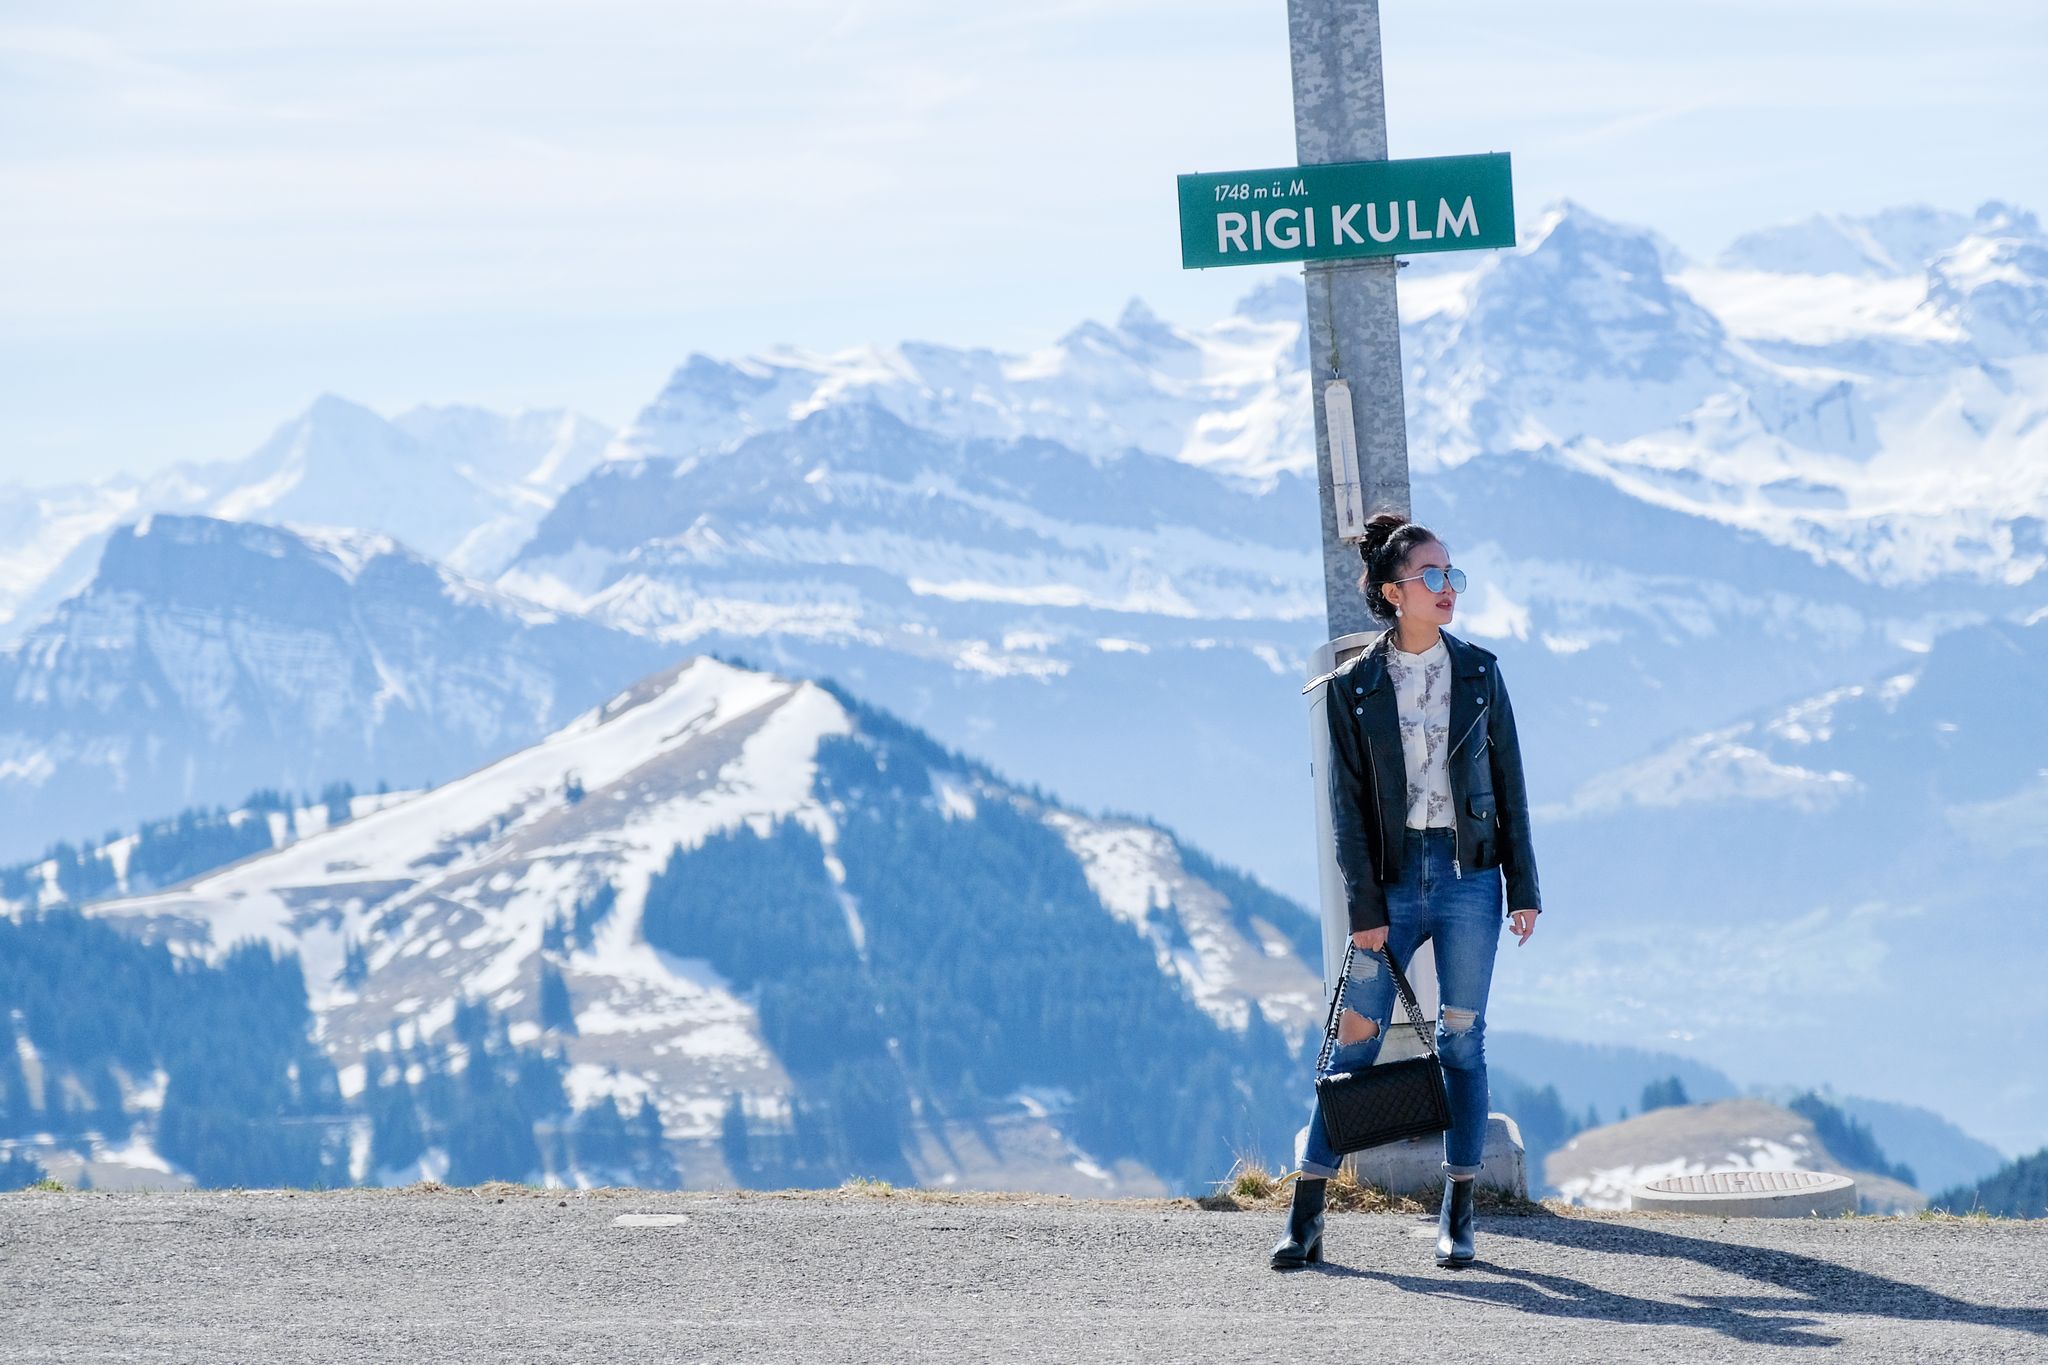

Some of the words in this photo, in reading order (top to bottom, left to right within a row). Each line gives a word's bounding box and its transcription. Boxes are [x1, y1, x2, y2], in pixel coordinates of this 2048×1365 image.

[1214, 183, 1250, 202] 1748
[1254, 187, 1268, 199] m
[1272, 181, 1285, 198] ü.
[1289, 179, 1309, 196] M.
[1216, 207, 1316, 253] RIGI
[1332, 195, 1480, 245] KULM
